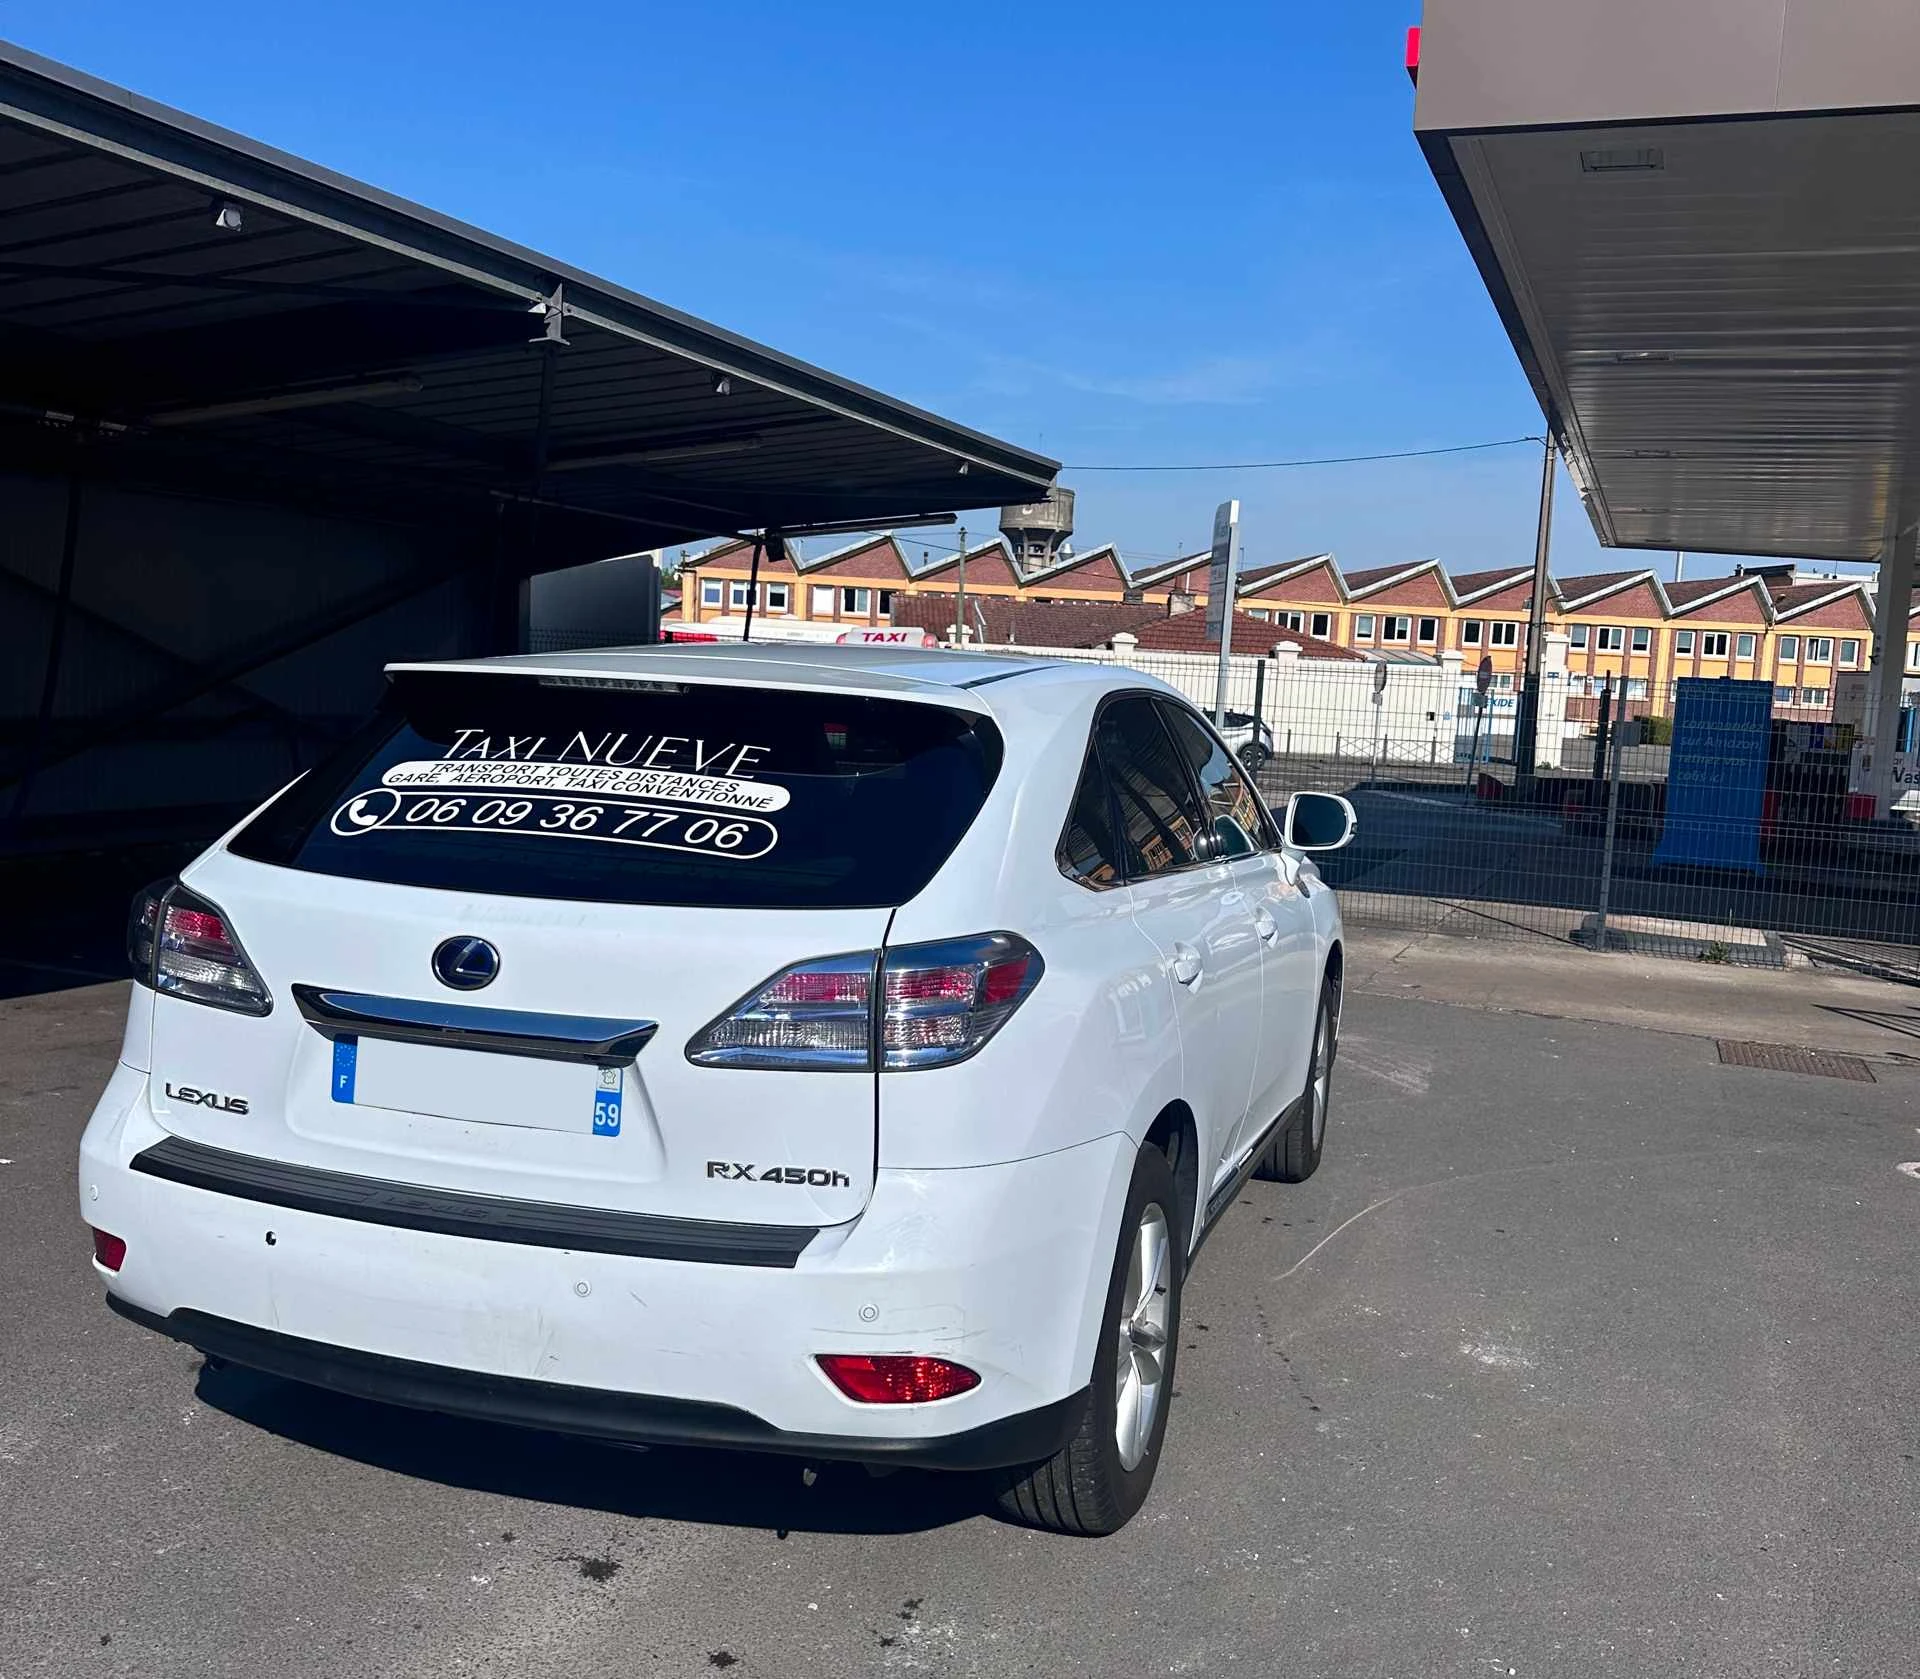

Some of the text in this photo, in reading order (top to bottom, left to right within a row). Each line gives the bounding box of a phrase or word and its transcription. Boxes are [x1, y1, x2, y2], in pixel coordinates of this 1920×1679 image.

[862, 632, 908, 643] TAXI
[1487, 697, 1515, 707] XIDE
[442, 729, 772, 779] TAXI NUEVE
[388, 773, 441, 784] GARE,
[564, 777, 607, 790] TAXI
[612, 782, 774, 809] CONVENTIONNÉ
[429, 763, 740, 793] TRANSPORT TOUTES DISTANCES
[405, 798, 749, 849] 06 09 36 77 06
[339, 1075, 349, 1089] F
[165, 1083, 250, 1116] LEXUS
[594, 1101, 619, 1128] 59
[706, 1160, 850, 1188] RX 450h
